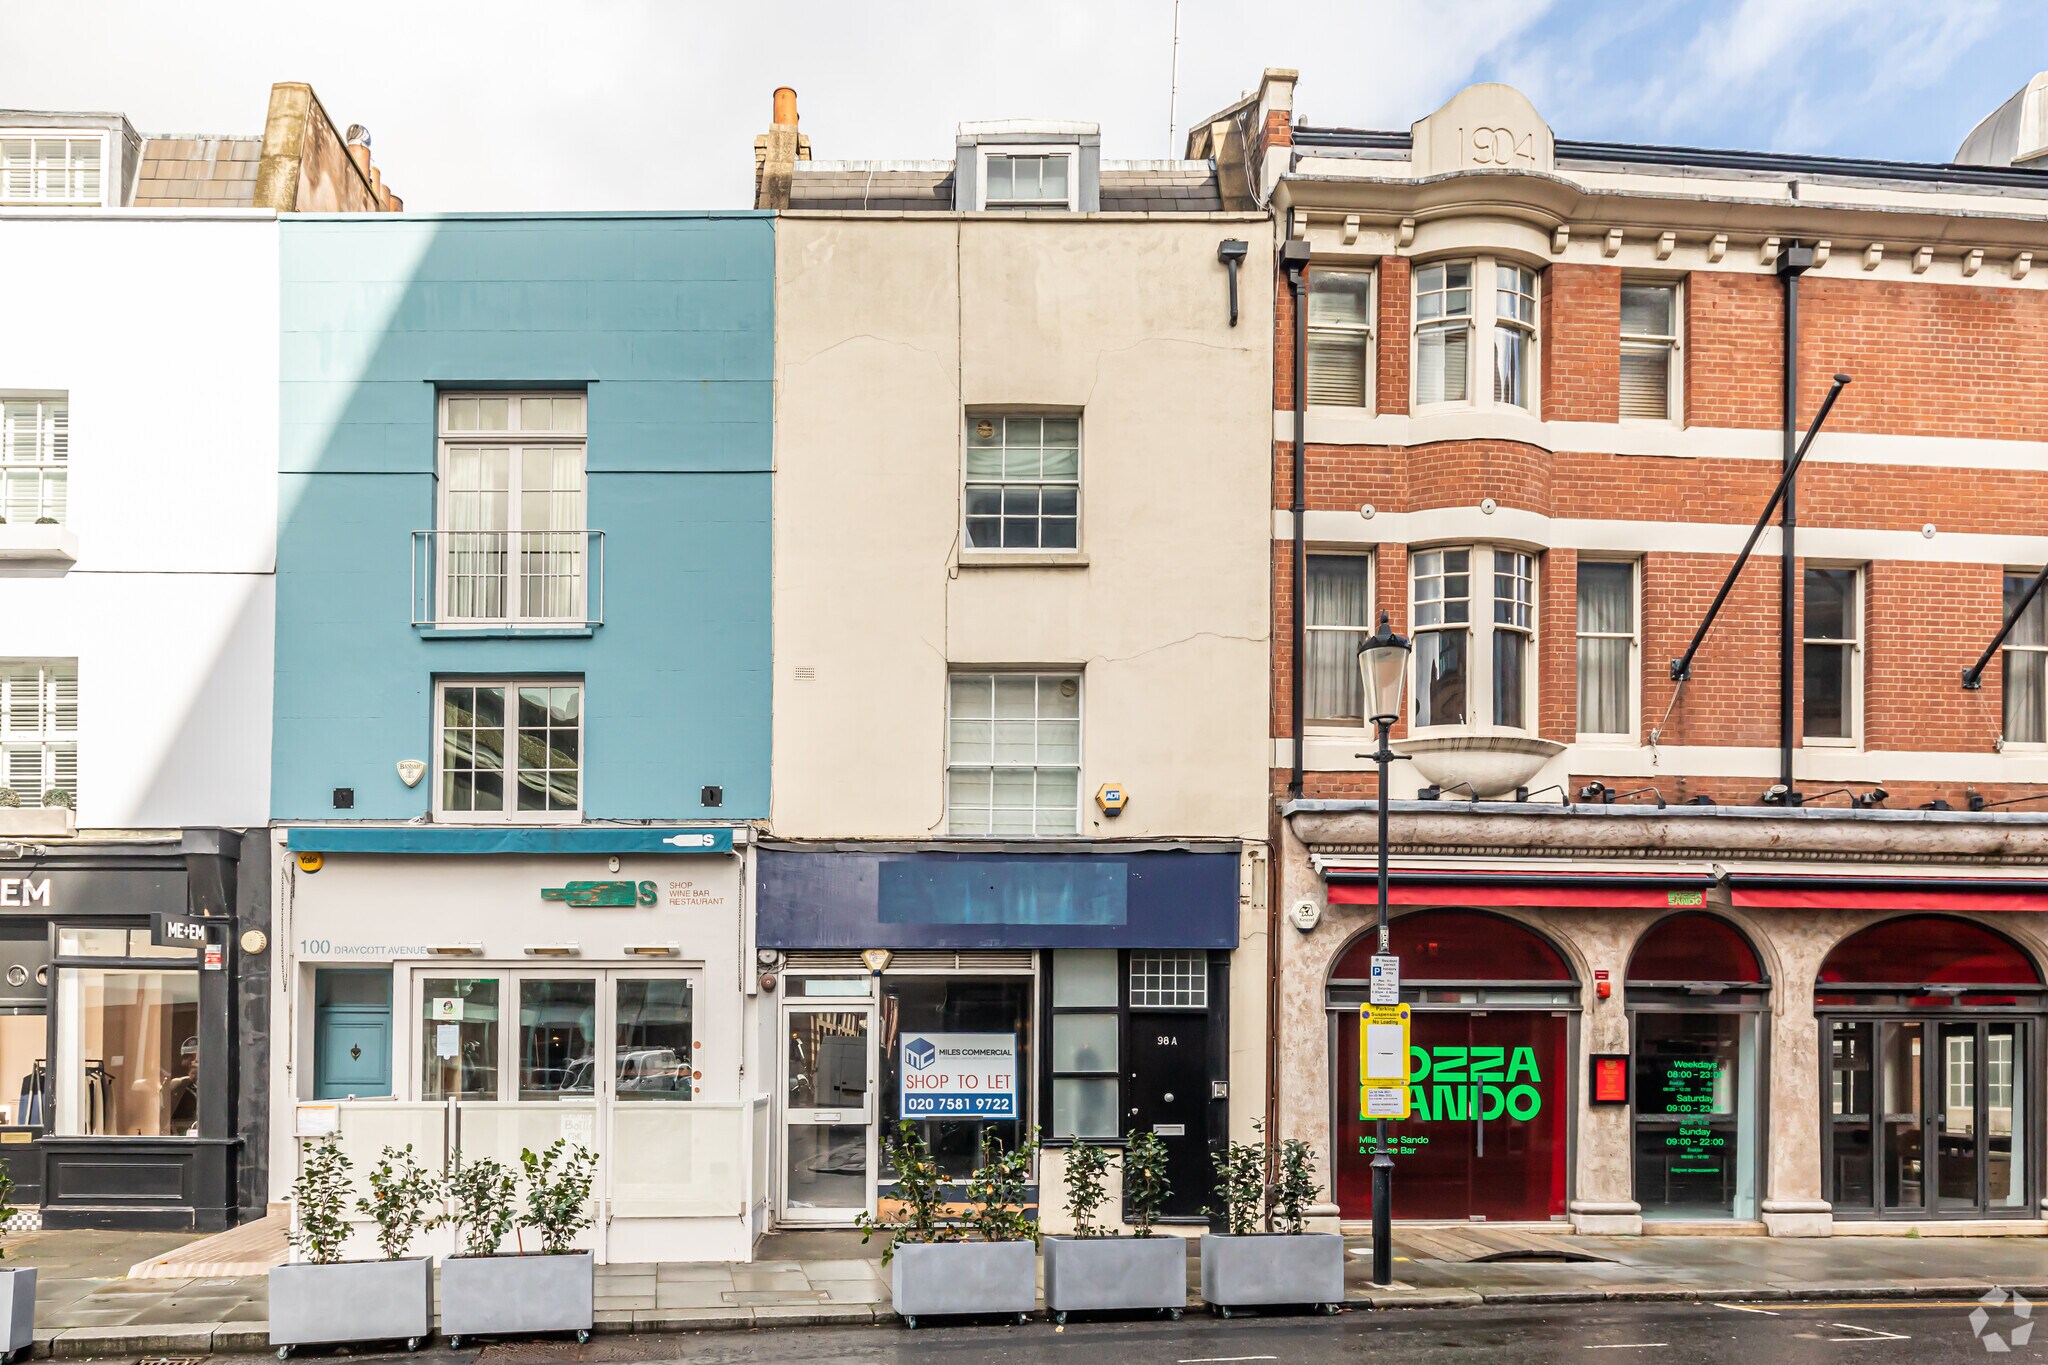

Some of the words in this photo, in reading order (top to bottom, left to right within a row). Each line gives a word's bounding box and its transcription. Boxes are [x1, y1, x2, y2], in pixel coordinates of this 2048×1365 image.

[1458, 126, 1536, 170] 1904
[1106, 791, 1120, 800] ADT
[300, 856, 318, 864] Yale
[669, 881, 693, 890] SHOP
[0, 878, 51, 907] EM
[669, 889, 691, 897] WINE
[692, 889, 710, 897] BAR
[669, 897, 725, 906] RESTAURANT
[1668, 898, 1703, 906] SANDO
[167, 921, 206, 941] ME+EM
[300, 939, 331, 955] 100
[334, 946, 386, 955] DRAYCOTT
[387, 946, 427, 955] AVENUE
[1157, 1036, 1170, 1046] 98
[1171, 1036, 1178, 1046] A
[1360, 1046, 1541, 1083] OZZA
[1673, 1060, 1718, 1070] Weekdays
[1667, 1070, 1692, 1079] 08:00
[906, 1074, 949, 1089] SHOP
[957, 1074, 979, 1089] TO
[987, 1074, 1011, 1089] LET
[1360, 1084, 1542, 1122] ANDO
[1676, 1094, 1715, 1103] Saturday
[908, 1098, 934, 1110] 020
[939, 1098, 970, 1110] 7581
[975, 1098, 1010, 1110] 9722
[1666, 1104, 1692, 1112] 09:00
[1679, 1127, 1711, 1137] Sunday
[1359, 1136, 1398, 1144] Milase
[1400, 1136, 1429, 1144] Sando
[1666, 1137, 1691, 1146] 09:00
[1699, 1137, 1724, 1146] 22:00
[1359, 1146, 1366, 1154] &
[1368, 1146, 1398, 1154] Cee
[1400, 1146, 1417, 1154] Bar
